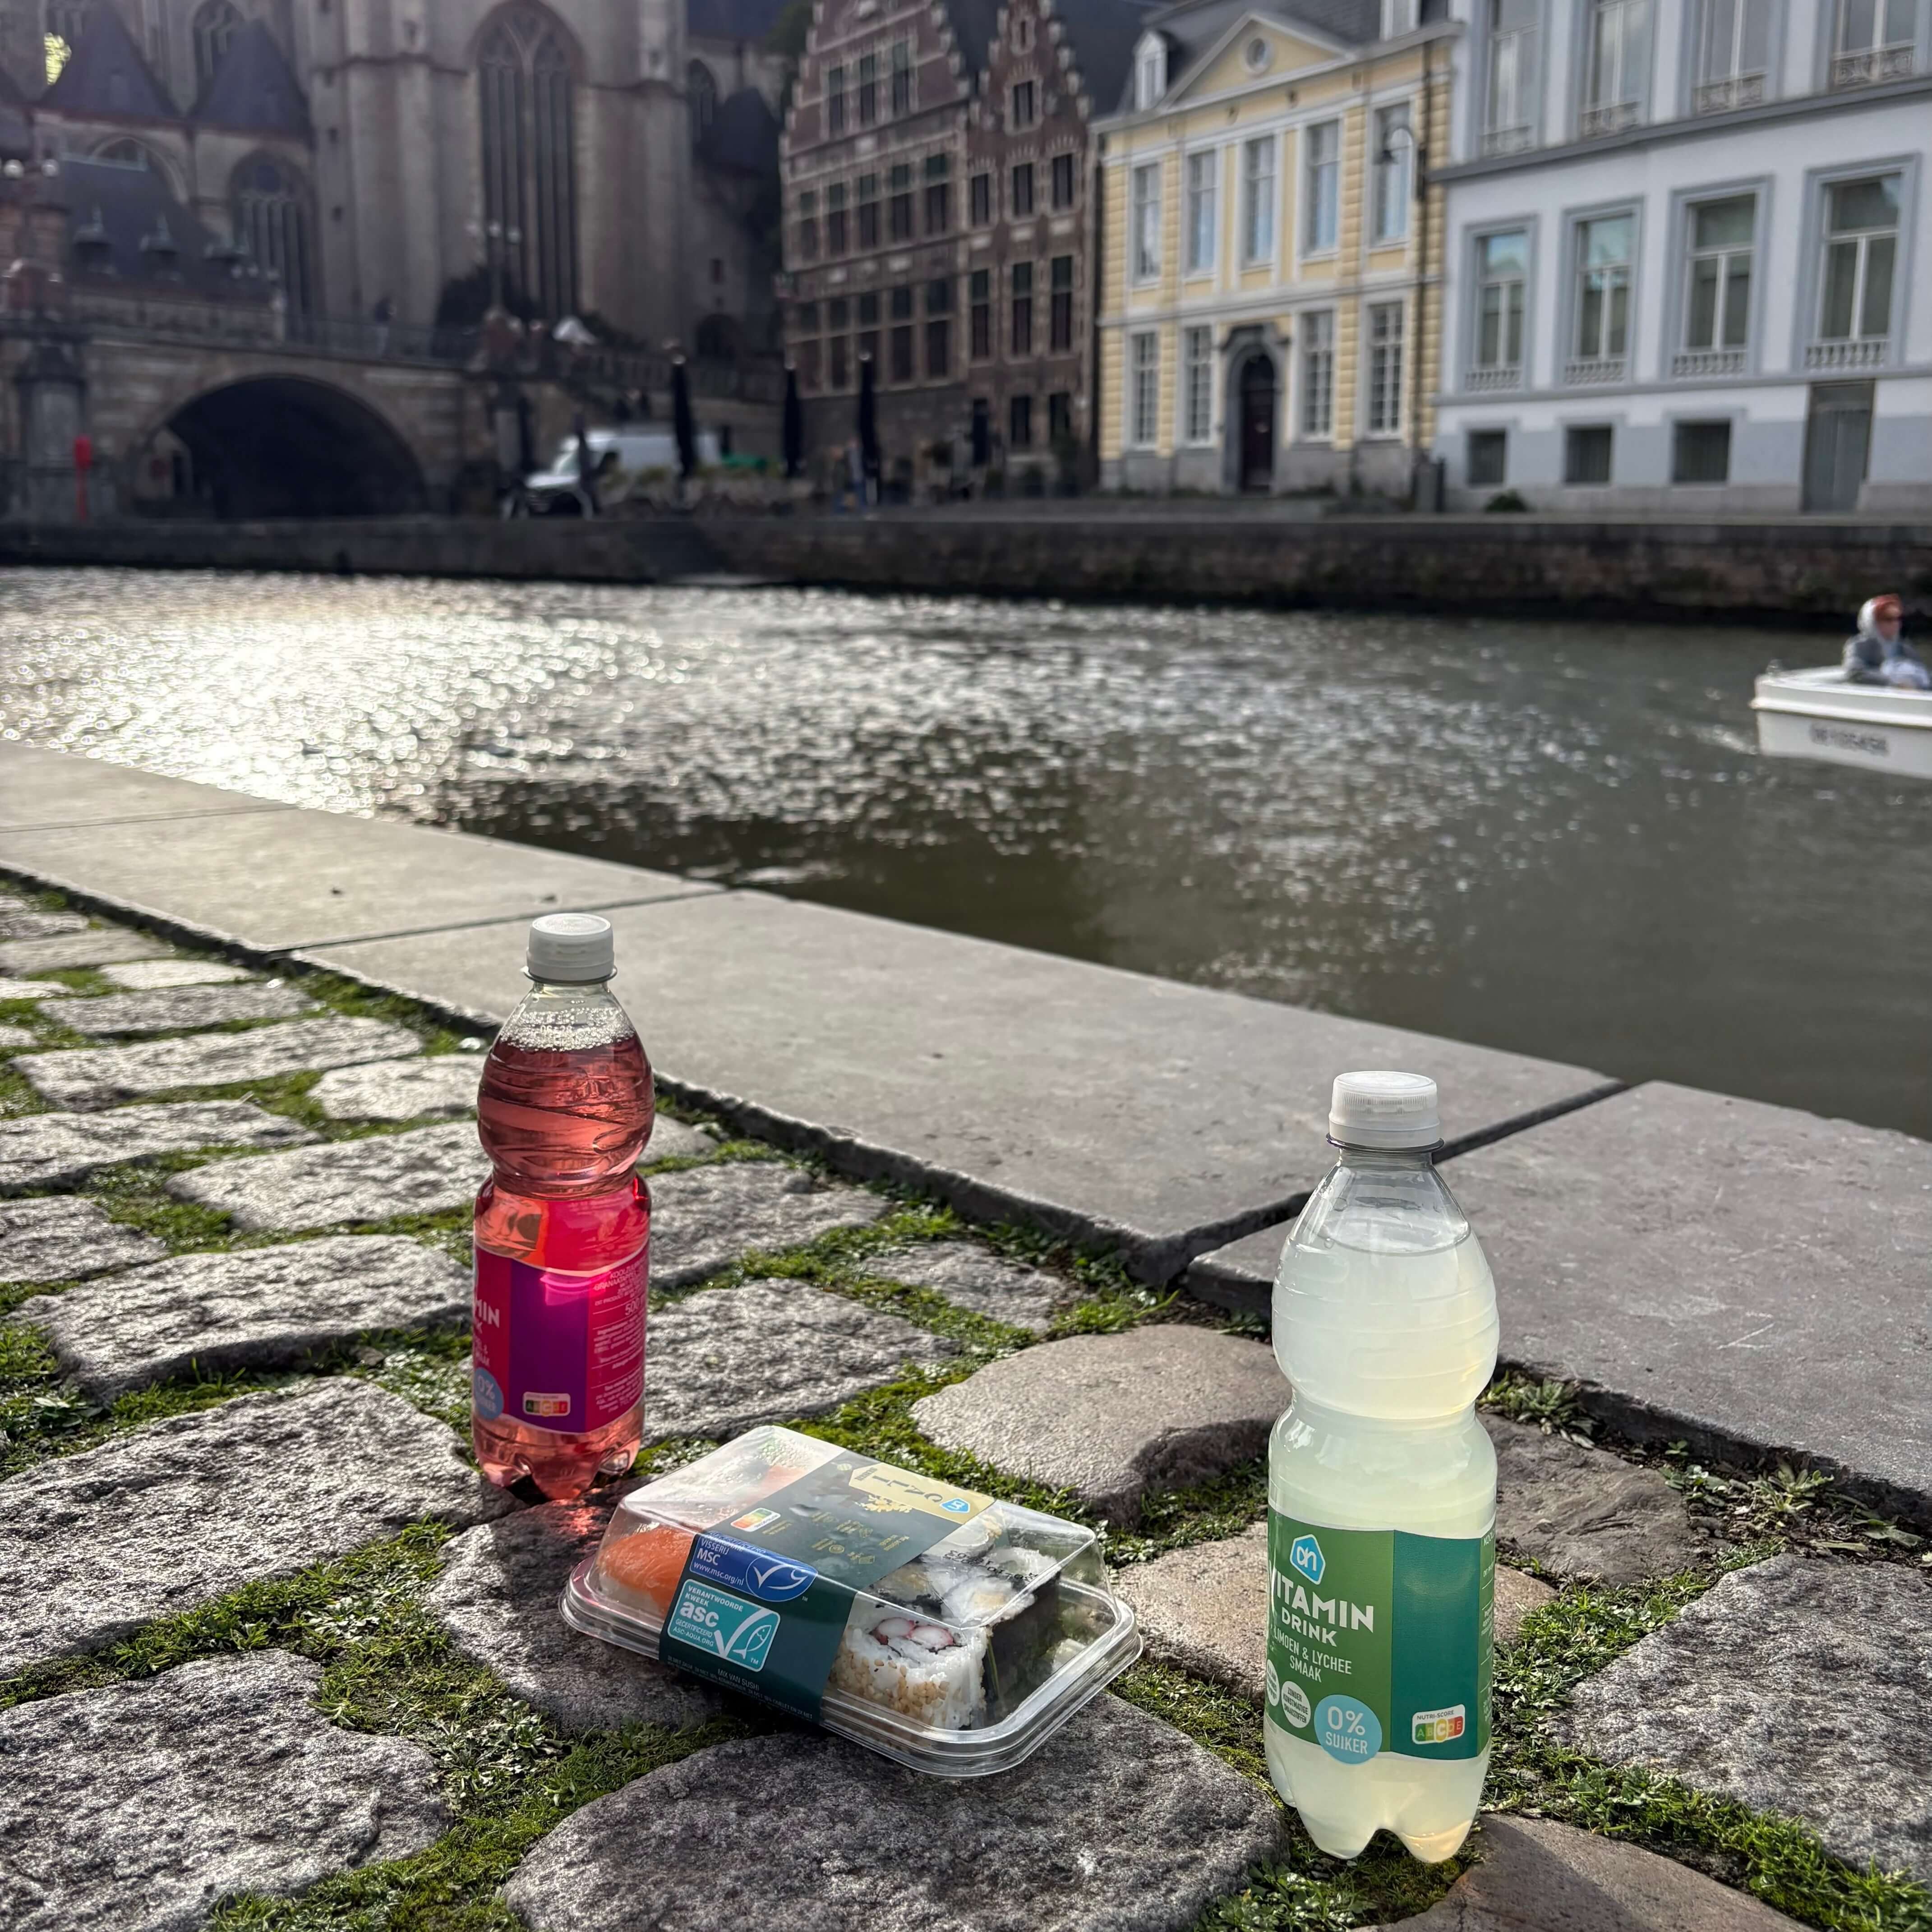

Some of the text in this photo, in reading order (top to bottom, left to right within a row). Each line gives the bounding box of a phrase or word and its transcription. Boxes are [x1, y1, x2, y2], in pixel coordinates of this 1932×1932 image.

[696, 1548, 721, 1566] MSC
[701, 1538, 729, 1555] VISSERIJ
[693, 1562, 744, 1586] www.msc.org/nl
[685, 1592, 710, 1607] KWEEK
[688, 1585, 744, 1612] VERANTWOORDE
[680, 1601, 719, 1628] asc
[675, 1618, 713, 1638] GECERTIFICEERD
[1282, 1606, 1337, 1647] DRINK
[1274, 1627, 1352, 1675] LIMOEN & LYCHEE
[1290, 1655, 1322, 1683] SMAAK
[729, 1673, 740, 1683] VAN
[742, 1678, 760, 1691] SUSHI
[1328, 1706, 1365, 1735] 0%
[1416, 1710, 1455, 1720] NUTRI-SCORE
[1438, 1724, 1446, 1737] C
[1325, 1731, 1368, 1754] SUIKER
